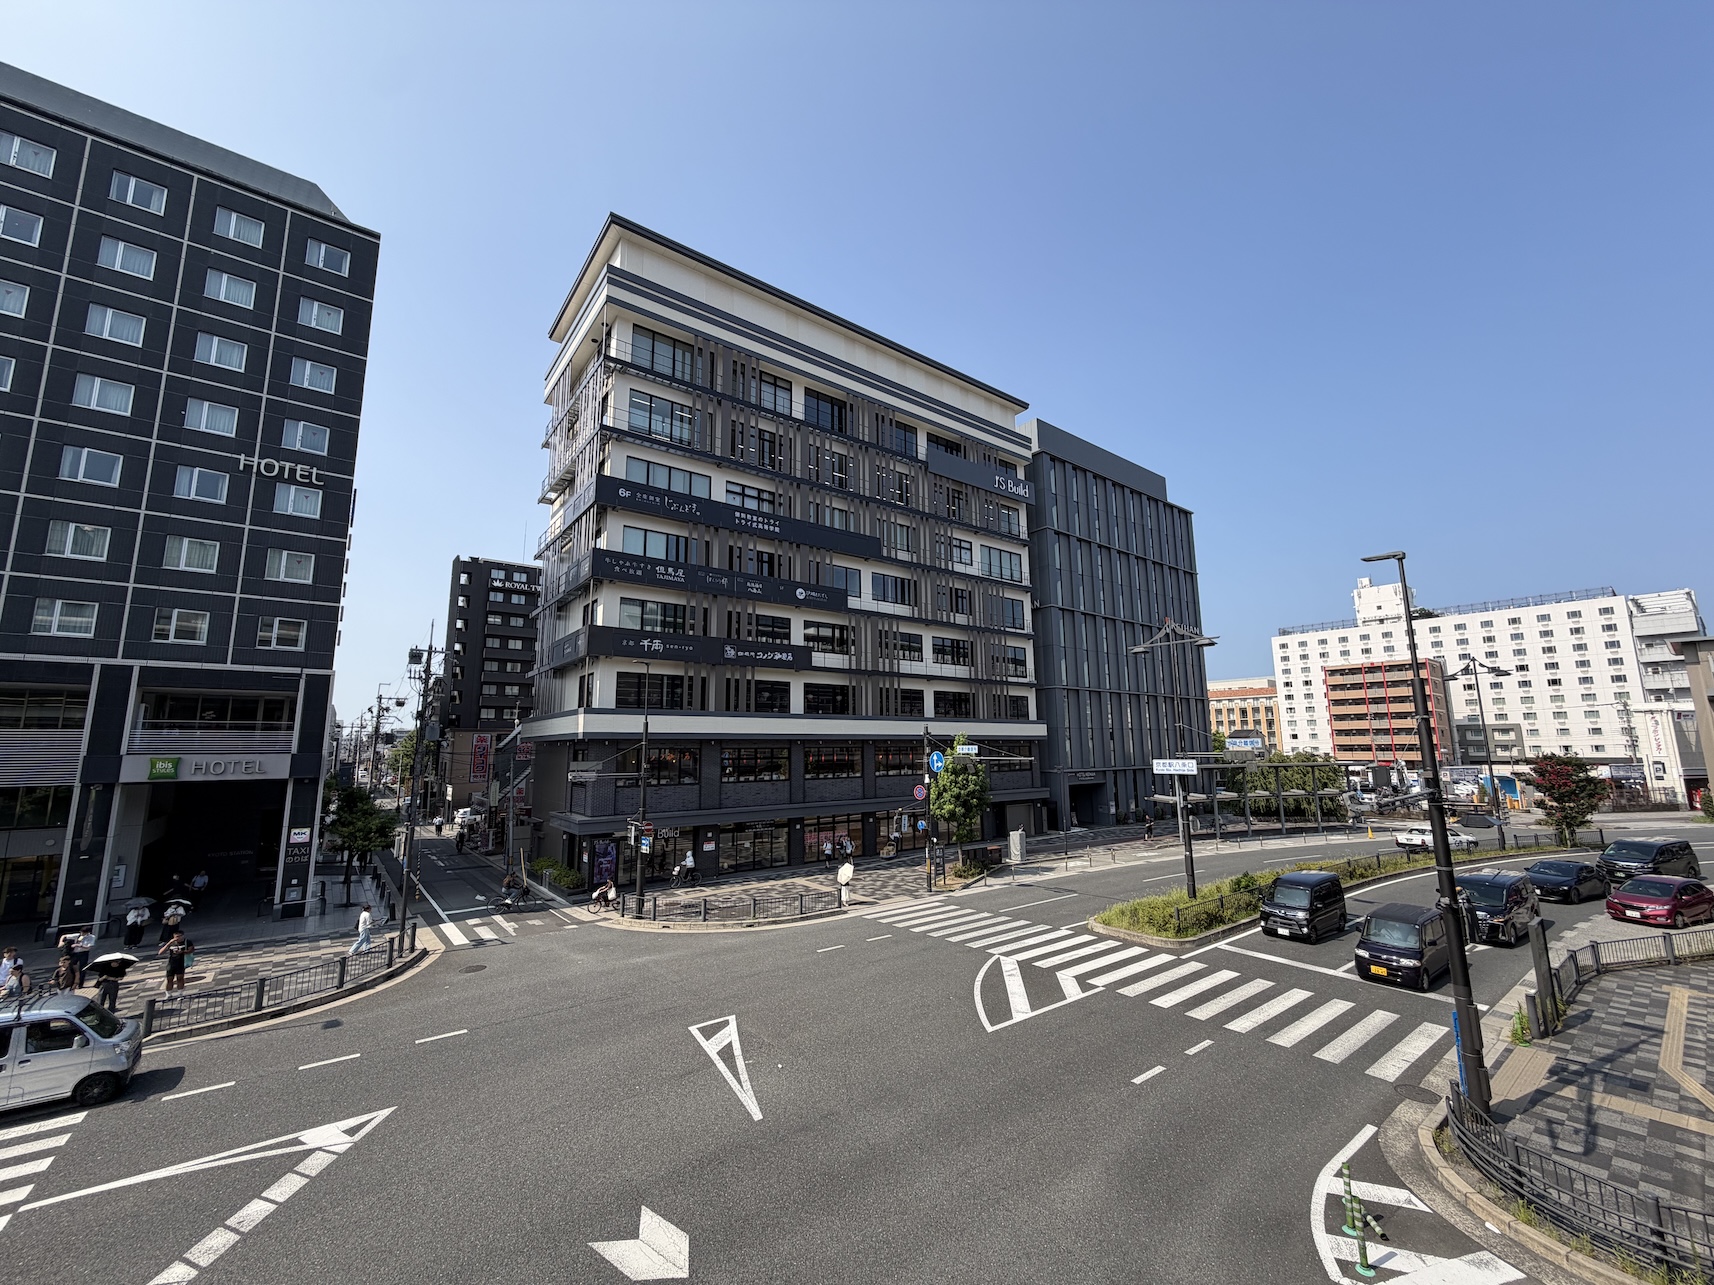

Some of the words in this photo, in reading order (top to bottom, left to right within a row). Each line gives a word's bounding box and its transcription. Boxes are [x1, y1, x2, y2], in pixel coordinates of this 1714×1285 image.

[239, 453, 324, 485] HOTEL
[993, 475, 1006, 490] JS
[1007, 479, 1029, 498] Build
[618, 488, 632, 498] 6F
[655, 565, 686, 578] 但馬屋
[656, 573, 685, 583] TAJIMAYA
[505, 581, 530, 591] ROYAL
[640, 638, 664, 653] 千両
[156, 760, 173, 769] ibis
[191, 759, 266, 775] HOTEL
[657, 828, 680, 839] Build
[287, 847, 310, 856] TAXI
[286, 855, 310, 863] のりば
